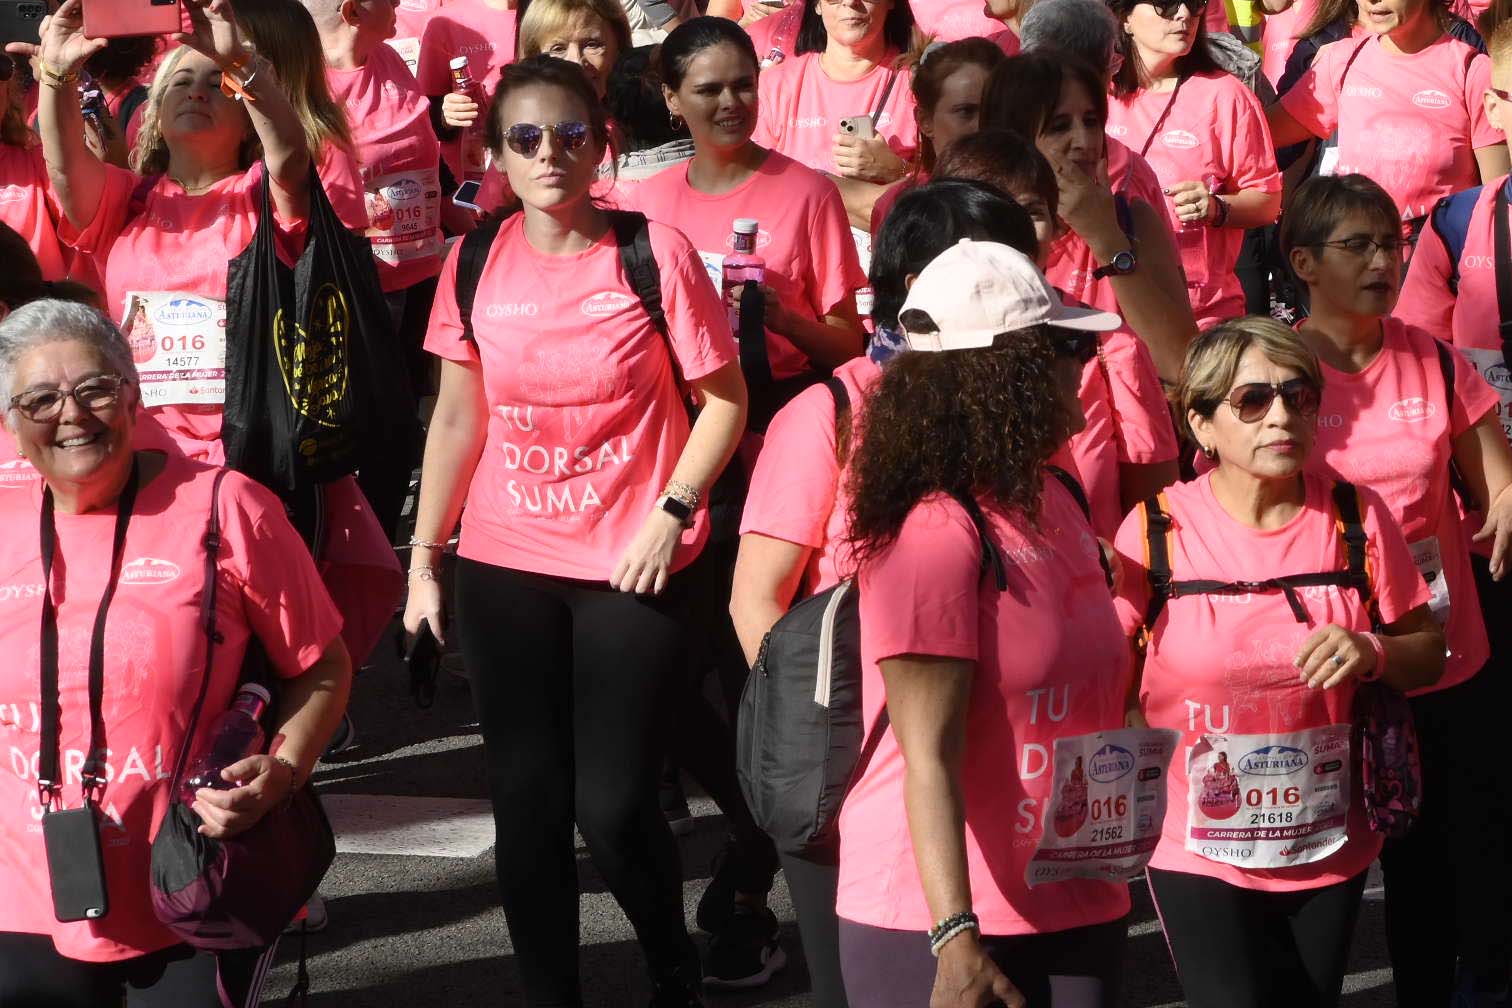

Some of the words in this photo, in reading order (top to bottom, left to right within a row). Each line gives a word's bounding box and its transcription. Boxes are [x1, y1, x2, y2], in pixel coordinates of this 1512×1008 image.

[486, 303, 538, 318] OYSHO
[161, 334, 205, 352] 016
[166, 356, 200, 368] 14577
[497, 405, 534, 432] TU
[502, 435, 636, 477] DORSAL
[506, 479, 603, 513] SUMA
[1027, 684, 1070, 726] TU
[1185, 699, 1230, 734] TU
[1244, 756, 1304, 772] ASTURIANA
[1246, 786, 1301, 807] 016
[1090, 794, 1128, 821] 016
[1250, 812, 1293, 825] 21618
[1207, 830, 1252, 839] CARRERA
[1253, 830, 1267, 838] DE
[1269, 829, 1281, 838] LA
[1202, 846, 1252, 859] OYSHO
